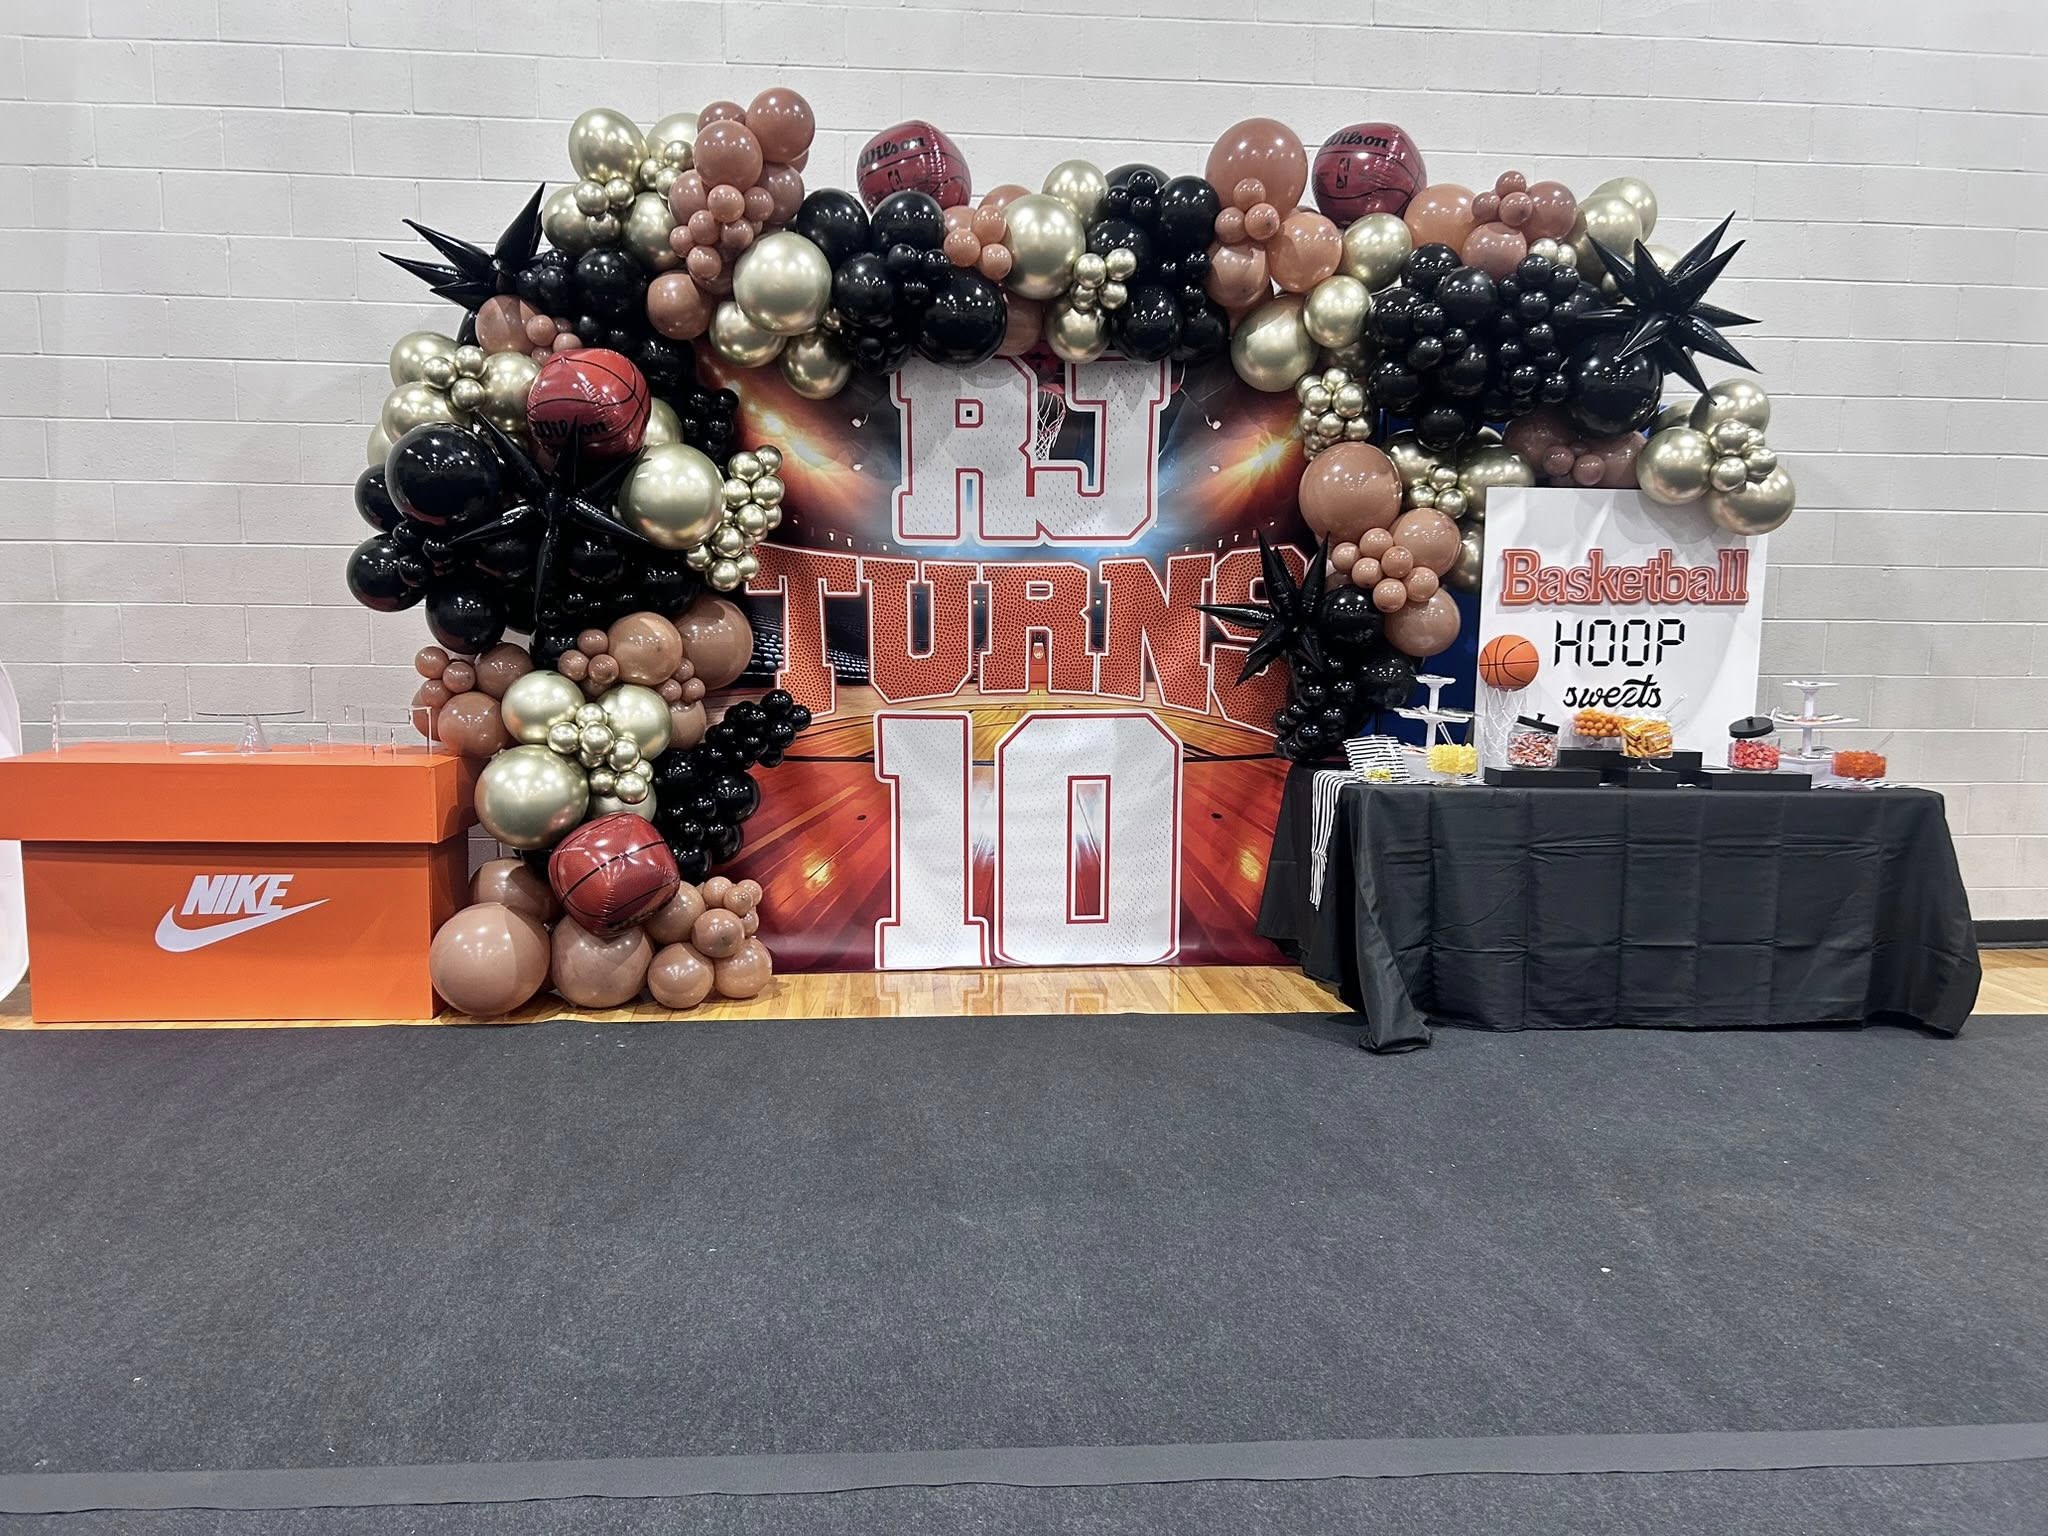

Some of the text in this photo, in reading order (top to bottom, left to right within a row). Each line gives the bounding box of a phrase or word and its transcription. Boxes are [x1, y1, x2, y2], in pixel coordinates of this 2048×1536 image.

[859, 136, 926, 168] Wilson
[1325, 131, 1389, 149] Wilson
[533, 419, 608, 439] Wilon
[890, 355, 1171, 546] RJ
[1501, 549, 1749, 606] Basketball
[1554, 619, 1686, 667] HOOP
[1563, 674, 1662, 708] sweets
[874, 711, 1183, 969] 10
[180, 874, 294, 915] NIKE
